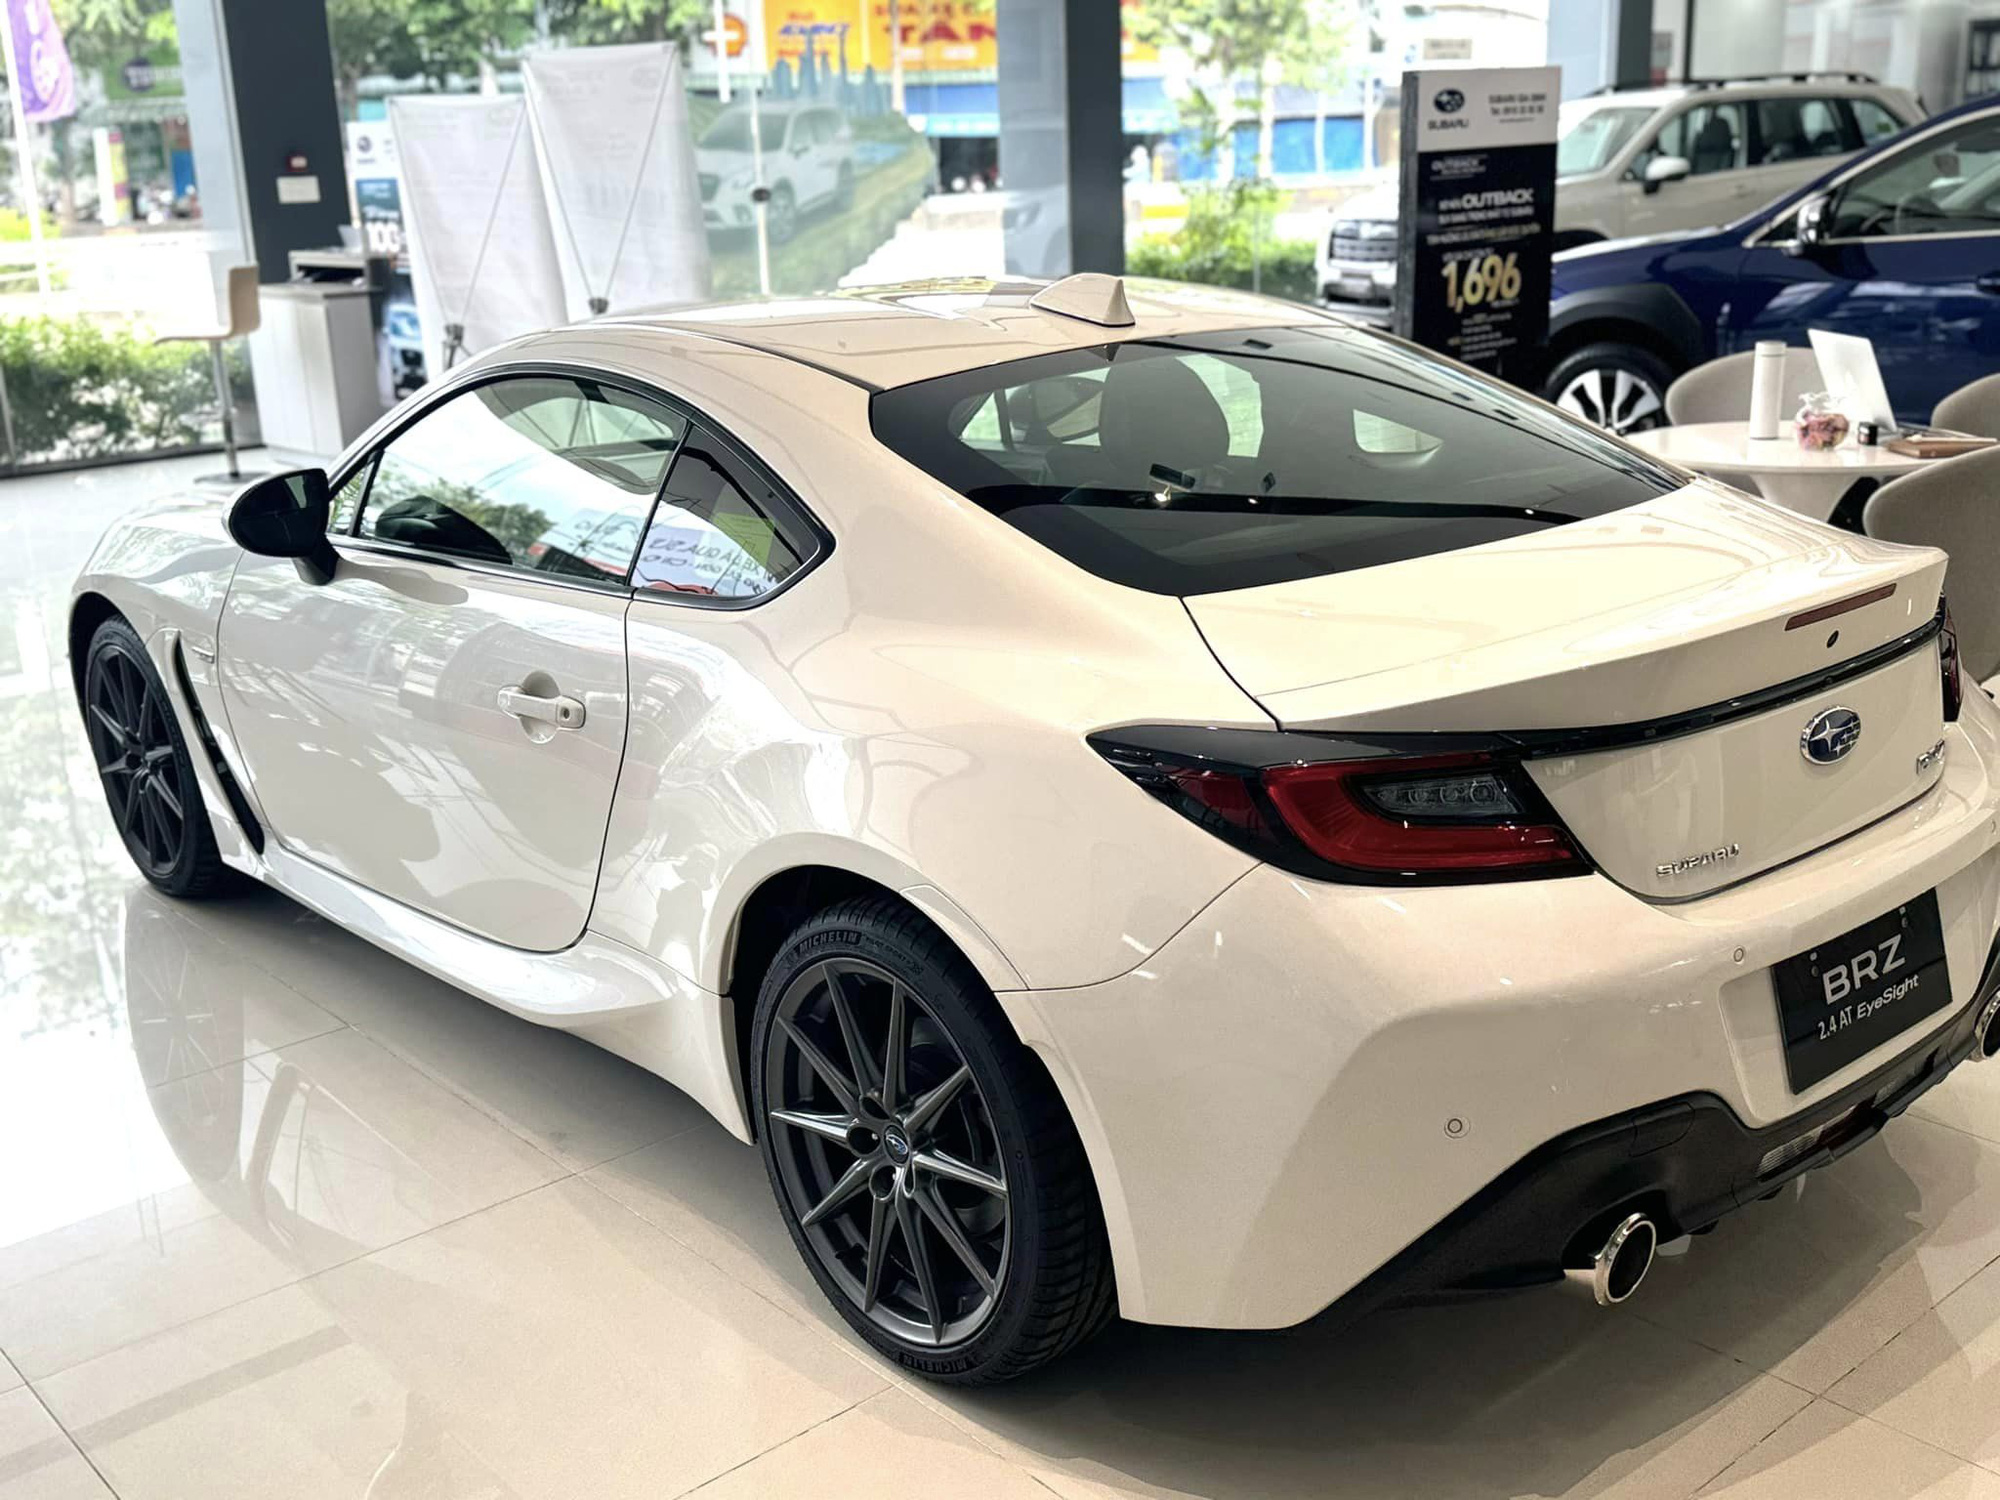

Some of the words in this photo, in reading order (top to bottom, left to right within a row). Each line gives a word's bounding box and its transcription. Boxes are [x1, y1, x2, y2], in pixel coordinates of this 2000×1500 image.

[1461, 188, 1535, 209] OUTBACK
[1441, 251, 1522, 314] 1,696
[1656, 843, 1740, 877] SUBARU
[800, 930, 860, 950] MICHELIN
[1822, 933, 1906, 1005] BRZ
[1818, 1015, 1837, 1040] 2.4
[1839, 1005, 1853, 1029] AT
[1856, 973, 1920, 1020] EyeSight
